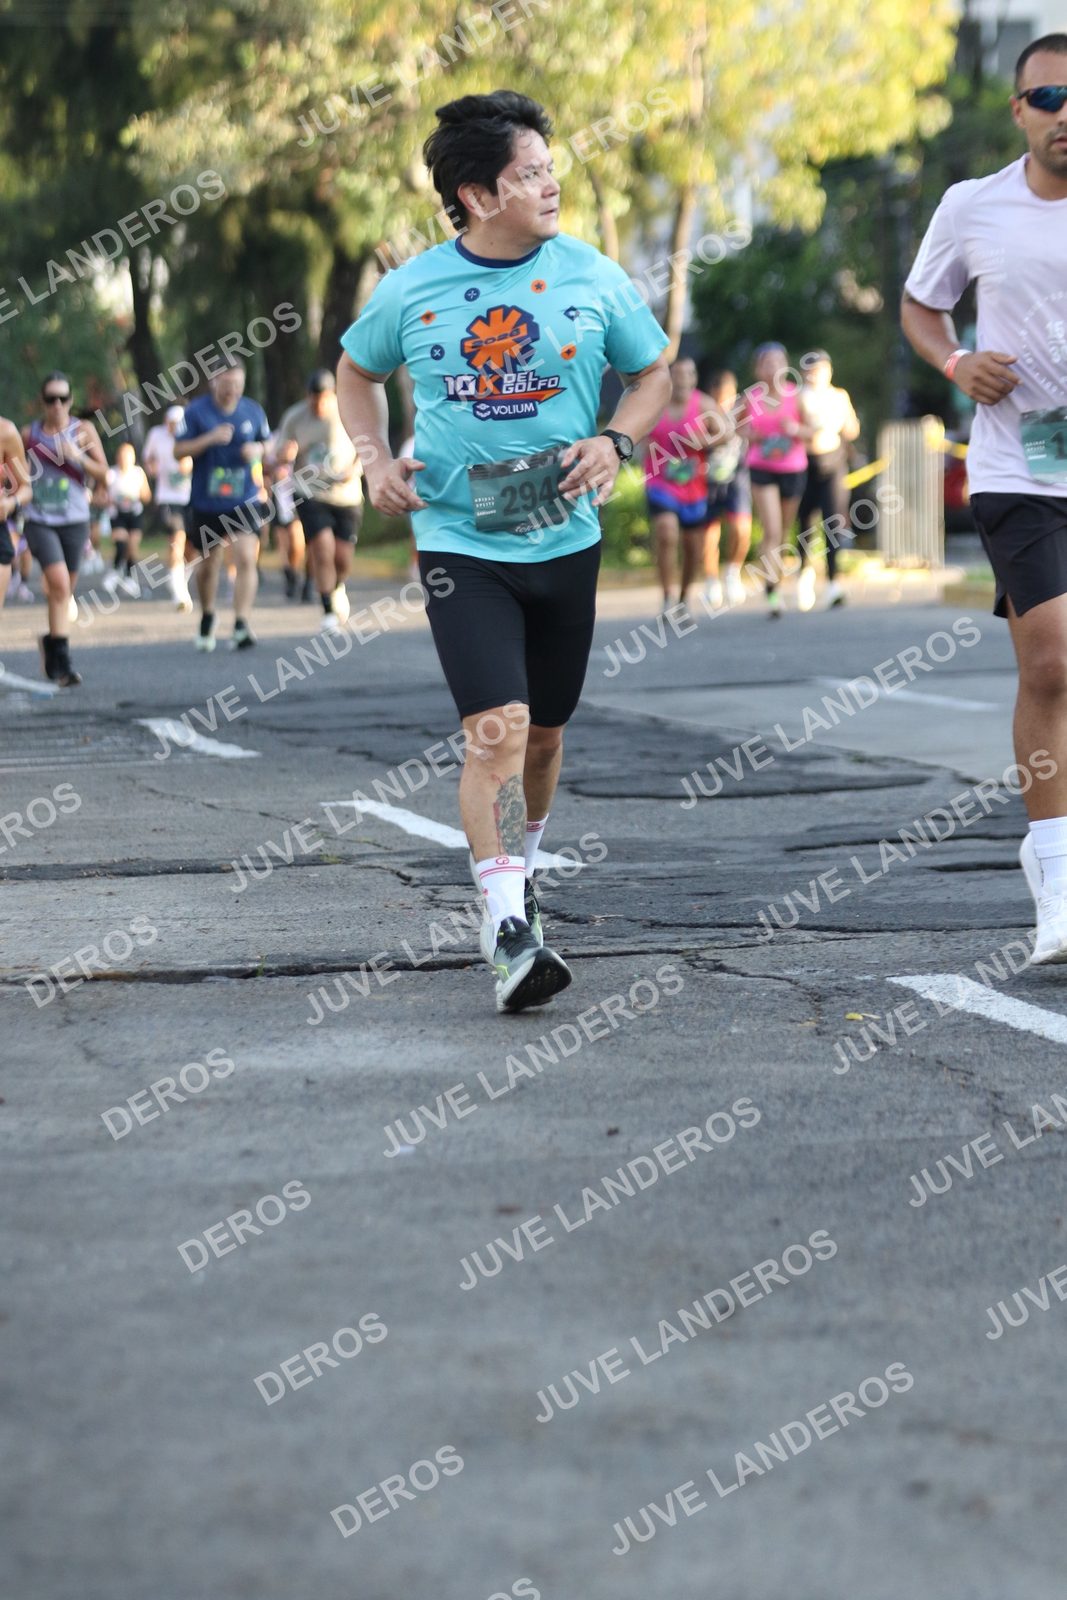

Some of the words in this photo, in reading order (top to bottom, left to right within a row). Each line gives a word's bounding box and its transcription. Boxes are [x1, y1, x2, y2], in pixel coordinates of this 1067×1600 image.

[445, 374, 499, 396] 10K
[504, 371, 538, 382] DEL
[502, 377, 559, 395] GOLFO
[491, 401, 535, 415] VOLIUM
[500, 473, 563, 517] 294
